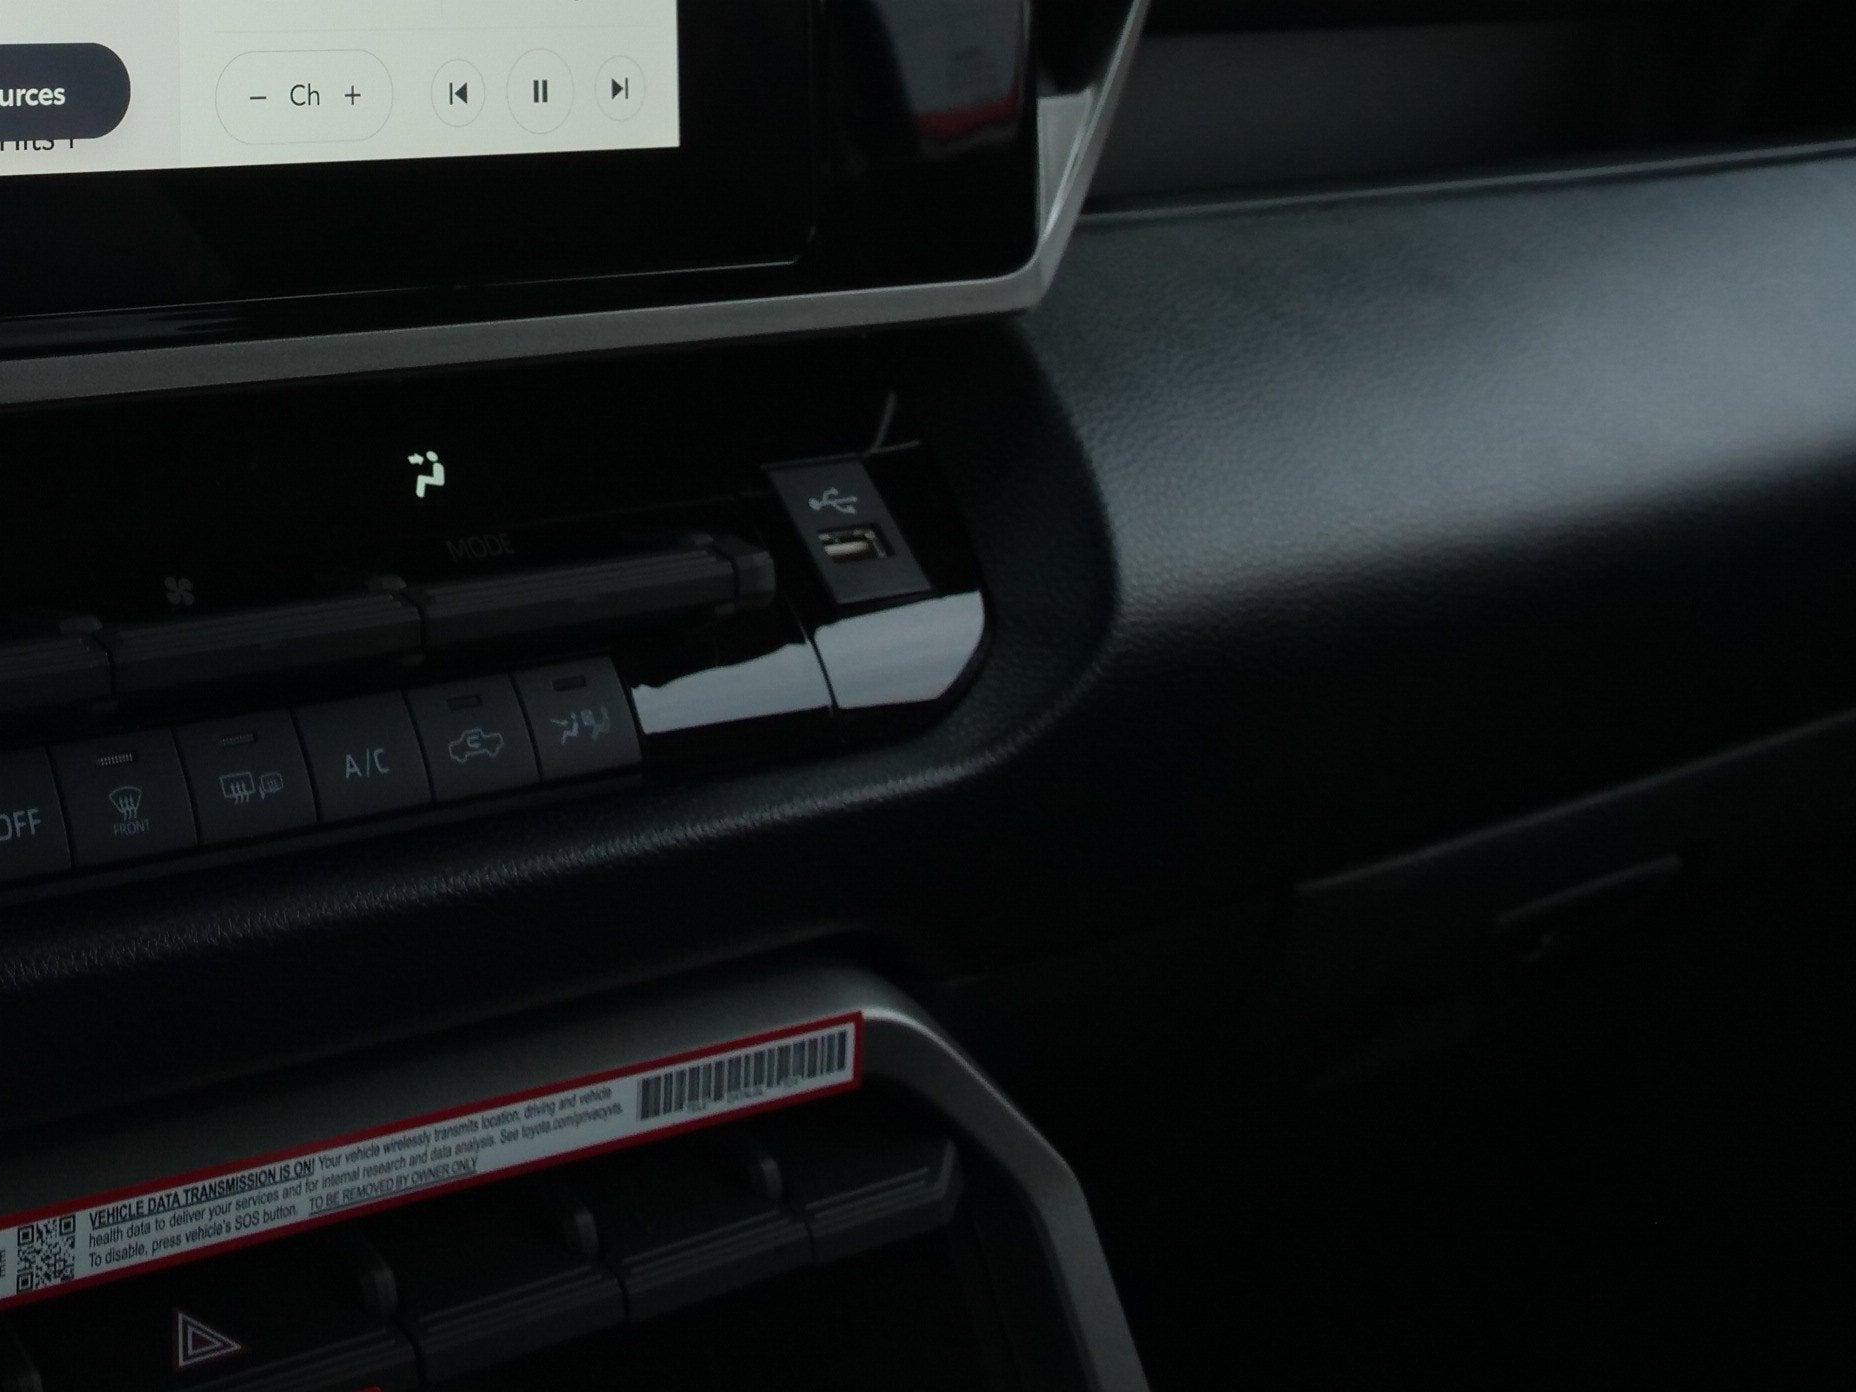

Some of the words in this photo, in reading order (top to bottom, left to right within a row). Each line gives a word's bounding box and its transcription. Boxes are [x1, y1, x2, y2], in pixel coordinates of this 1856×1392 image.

[290, 84, 320, 107] Ch
[448, 533, 513, 562] MODE
[344, 750, 390, 779] A/C
[113, 818, 150, 838] FRONT
[89, 1199, 143, 1228] VEHICLE
[147, 1192, 180, 1214] DATA
[184, 1170, 276, 1205] TRANSMISSION
[279, 1164, 290, 1181] IS
[294, 1158, 315, 1178] ON!
[319, 1153, 342, 1171] Your
[345, 1143, 380, 1164] vehicle
[383, 1130, 431, 1153] wirelessly
[434, 1117, 479, 1142] transmits
[559, 1094, 576, 1109] and
[579, 1087, 612, 1104] vehicle
[89, 1226, 123, 1248] health
[127, 1221, 151, 1239] data
[155, 1216, 165, 1231] to
[169, 1207, 206, 1228] deliver
[208, 1202, 232, 1222] your
[235, 1191, 279, 1211] services
[282, 1183, 302, 1200] and
[305, 1176, 319, 1193] for
[322, 1167, 360, 1189] internal
[363, 1155, 406, 1179] research
[409, 1148, 427, 1166] and
[430, 1141, 452, 1161] data
[500, 1128, 518, 1144] See
[89, 1252, 101, 1268] To
[105, 1242, 148, 1265] disable,
[151, 1234, 182, 1254] press
[185, 1220, 232, 1244] vehicle's
[235, 1211, 260, 1231] SOS
[309, 1196, 324, 1212] TO
[325, 1191, 340, 1207] BE
[342, 1177, 394, 1204] REMOVED
[395, 1172, 410, 1190] BY
[411, 1162, 449, 1185] OWNER
[451, 1157, 479, 1175] ONLY
